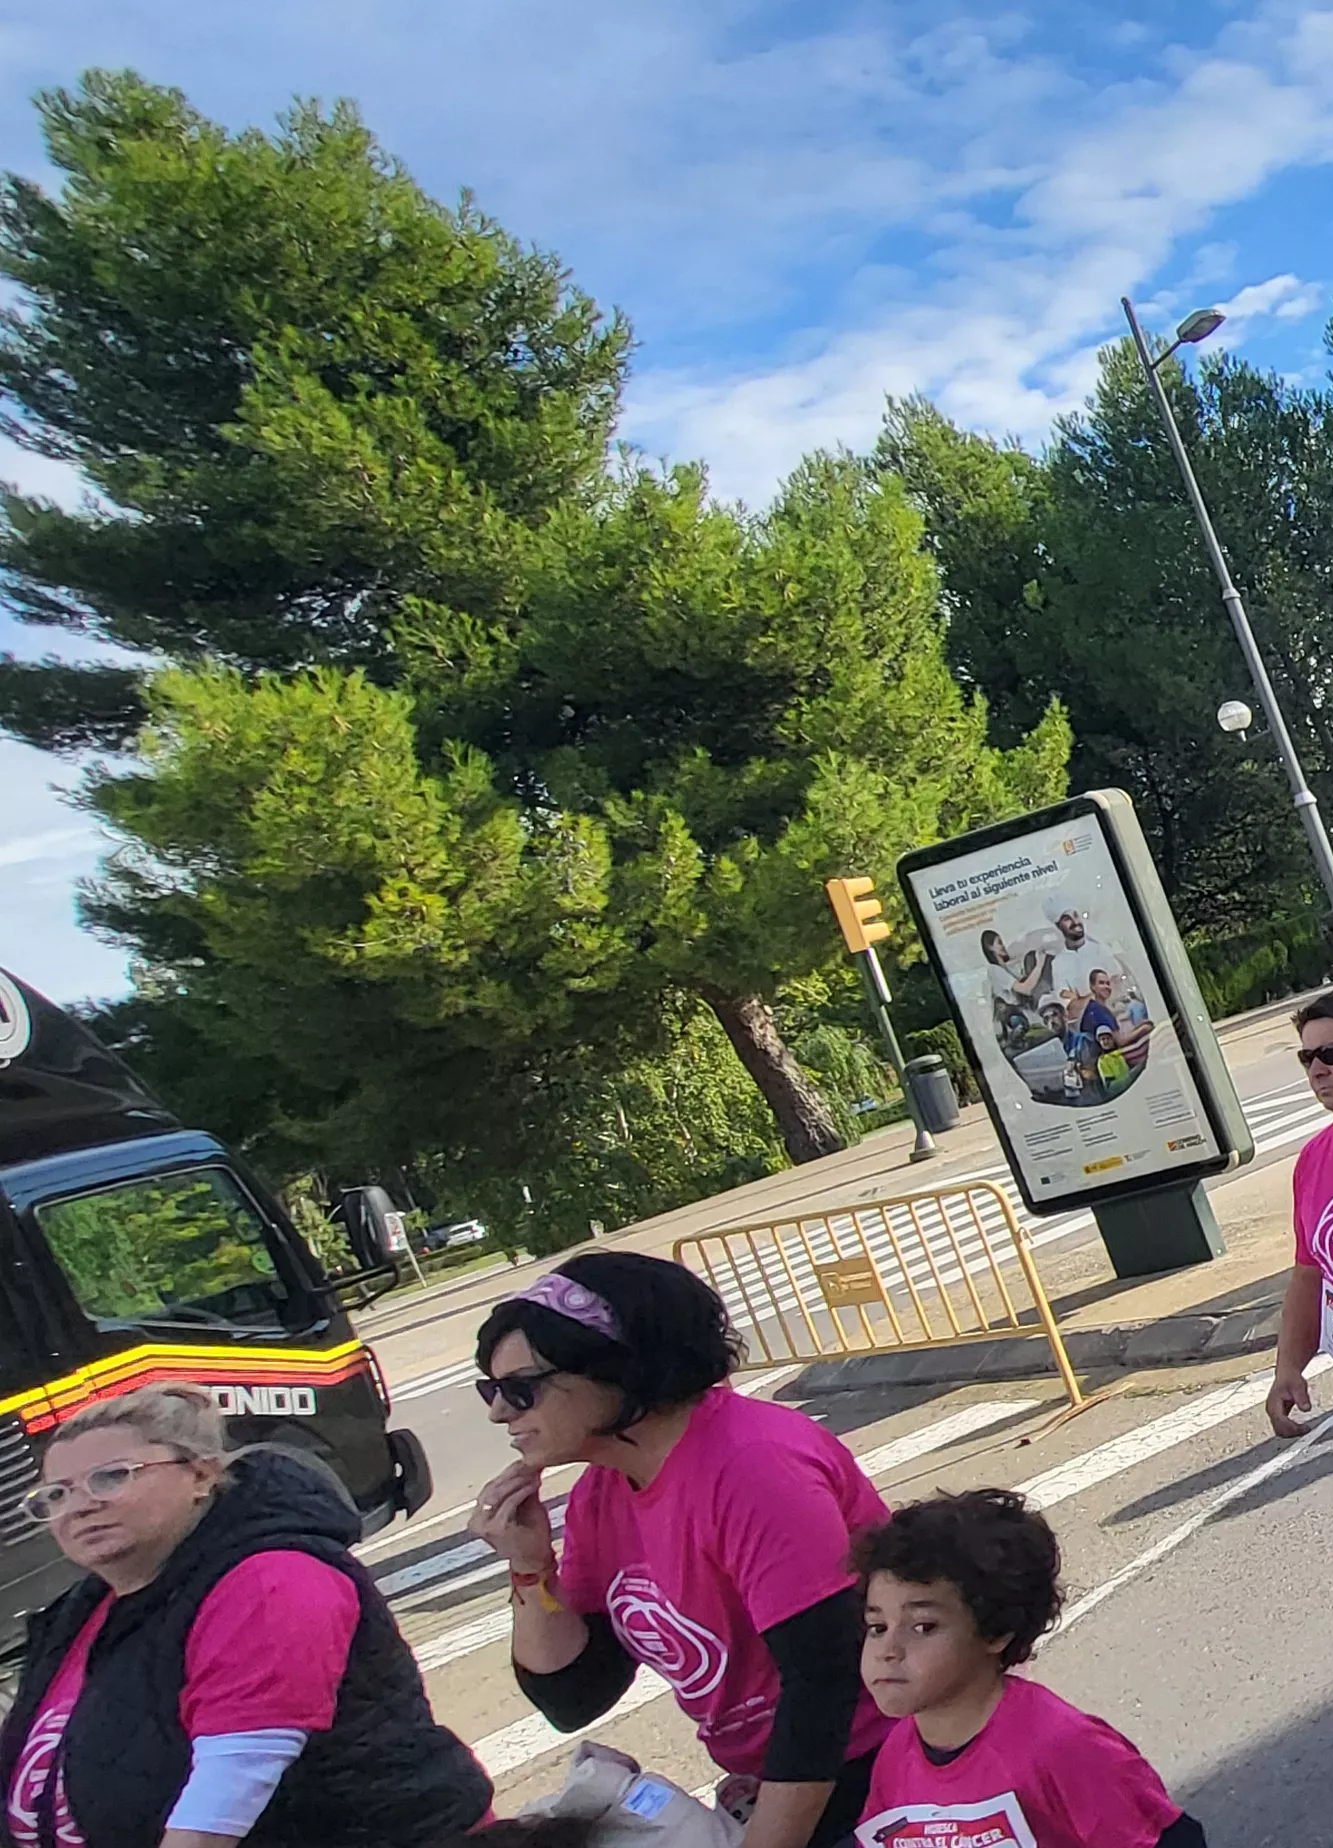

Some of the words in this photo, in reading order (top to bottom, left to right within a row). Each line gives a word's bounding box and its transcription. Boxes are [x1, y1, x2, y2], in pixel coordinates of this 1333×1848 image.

[929, 884, 956, 899] Lleva
[957, 879, 967, 889] tu
[969, 857, 1032, 884] experiencia
[933, 892, 969, 912] laboral
[971, 887, 982, 900] al
[983, 872, 1031, 895] siguiente
[1031, 860, 1058, 879] nivel
[199, 1385, 316, 1415] ONIDO
